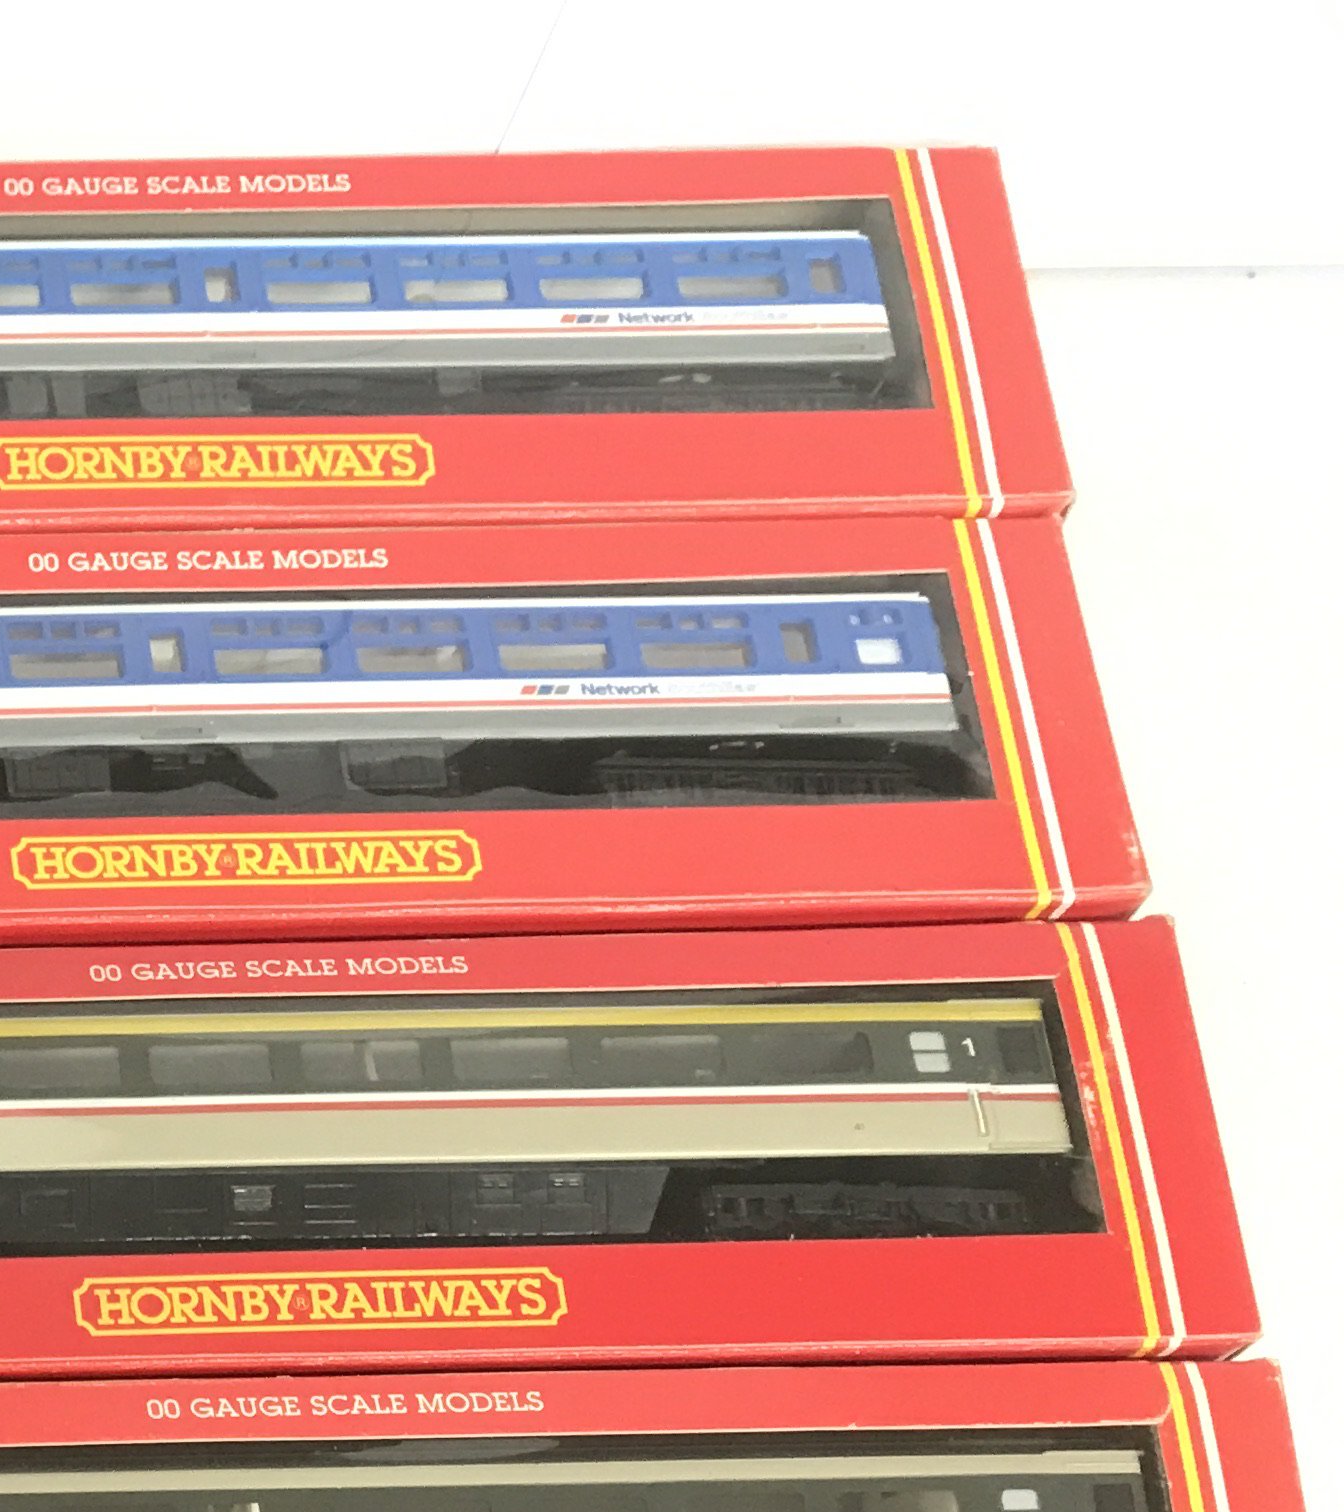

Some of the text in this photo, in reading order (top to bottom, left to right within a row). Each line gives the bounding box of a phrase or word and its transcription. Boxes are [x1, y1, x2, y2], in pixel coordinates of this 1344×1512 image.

[41, 176, 139, 196] GAUGE
[146, 175, 231, 195] SCALE
[239, 173, 352, 193] MODELS
[618, 311, 693, 323] Network
[198, 444, 416, 477] RAILWAYS
[67, 551, 169, 573] GAUGE
[176, 550, 265, 571] SCALE
[271, 548, 389, 570] MODELS
[580, 682, 660, 696] Network
[233, 839, 462, 875] RAILWAYS
[130, 961, 237, 981] GAUGE
[245, 958, 338, 978] SCALE
[345, 955, 469, 976] MODELS
[962, 1037, 976, 1057] 1
[306, 1278, 546, 1319] RAILWAYS
[190, 1396, 302, 1419] GAUGE
[310, 1393, 408, 1416] SCALE
[415, 1391, 545, 1414] MODELS
